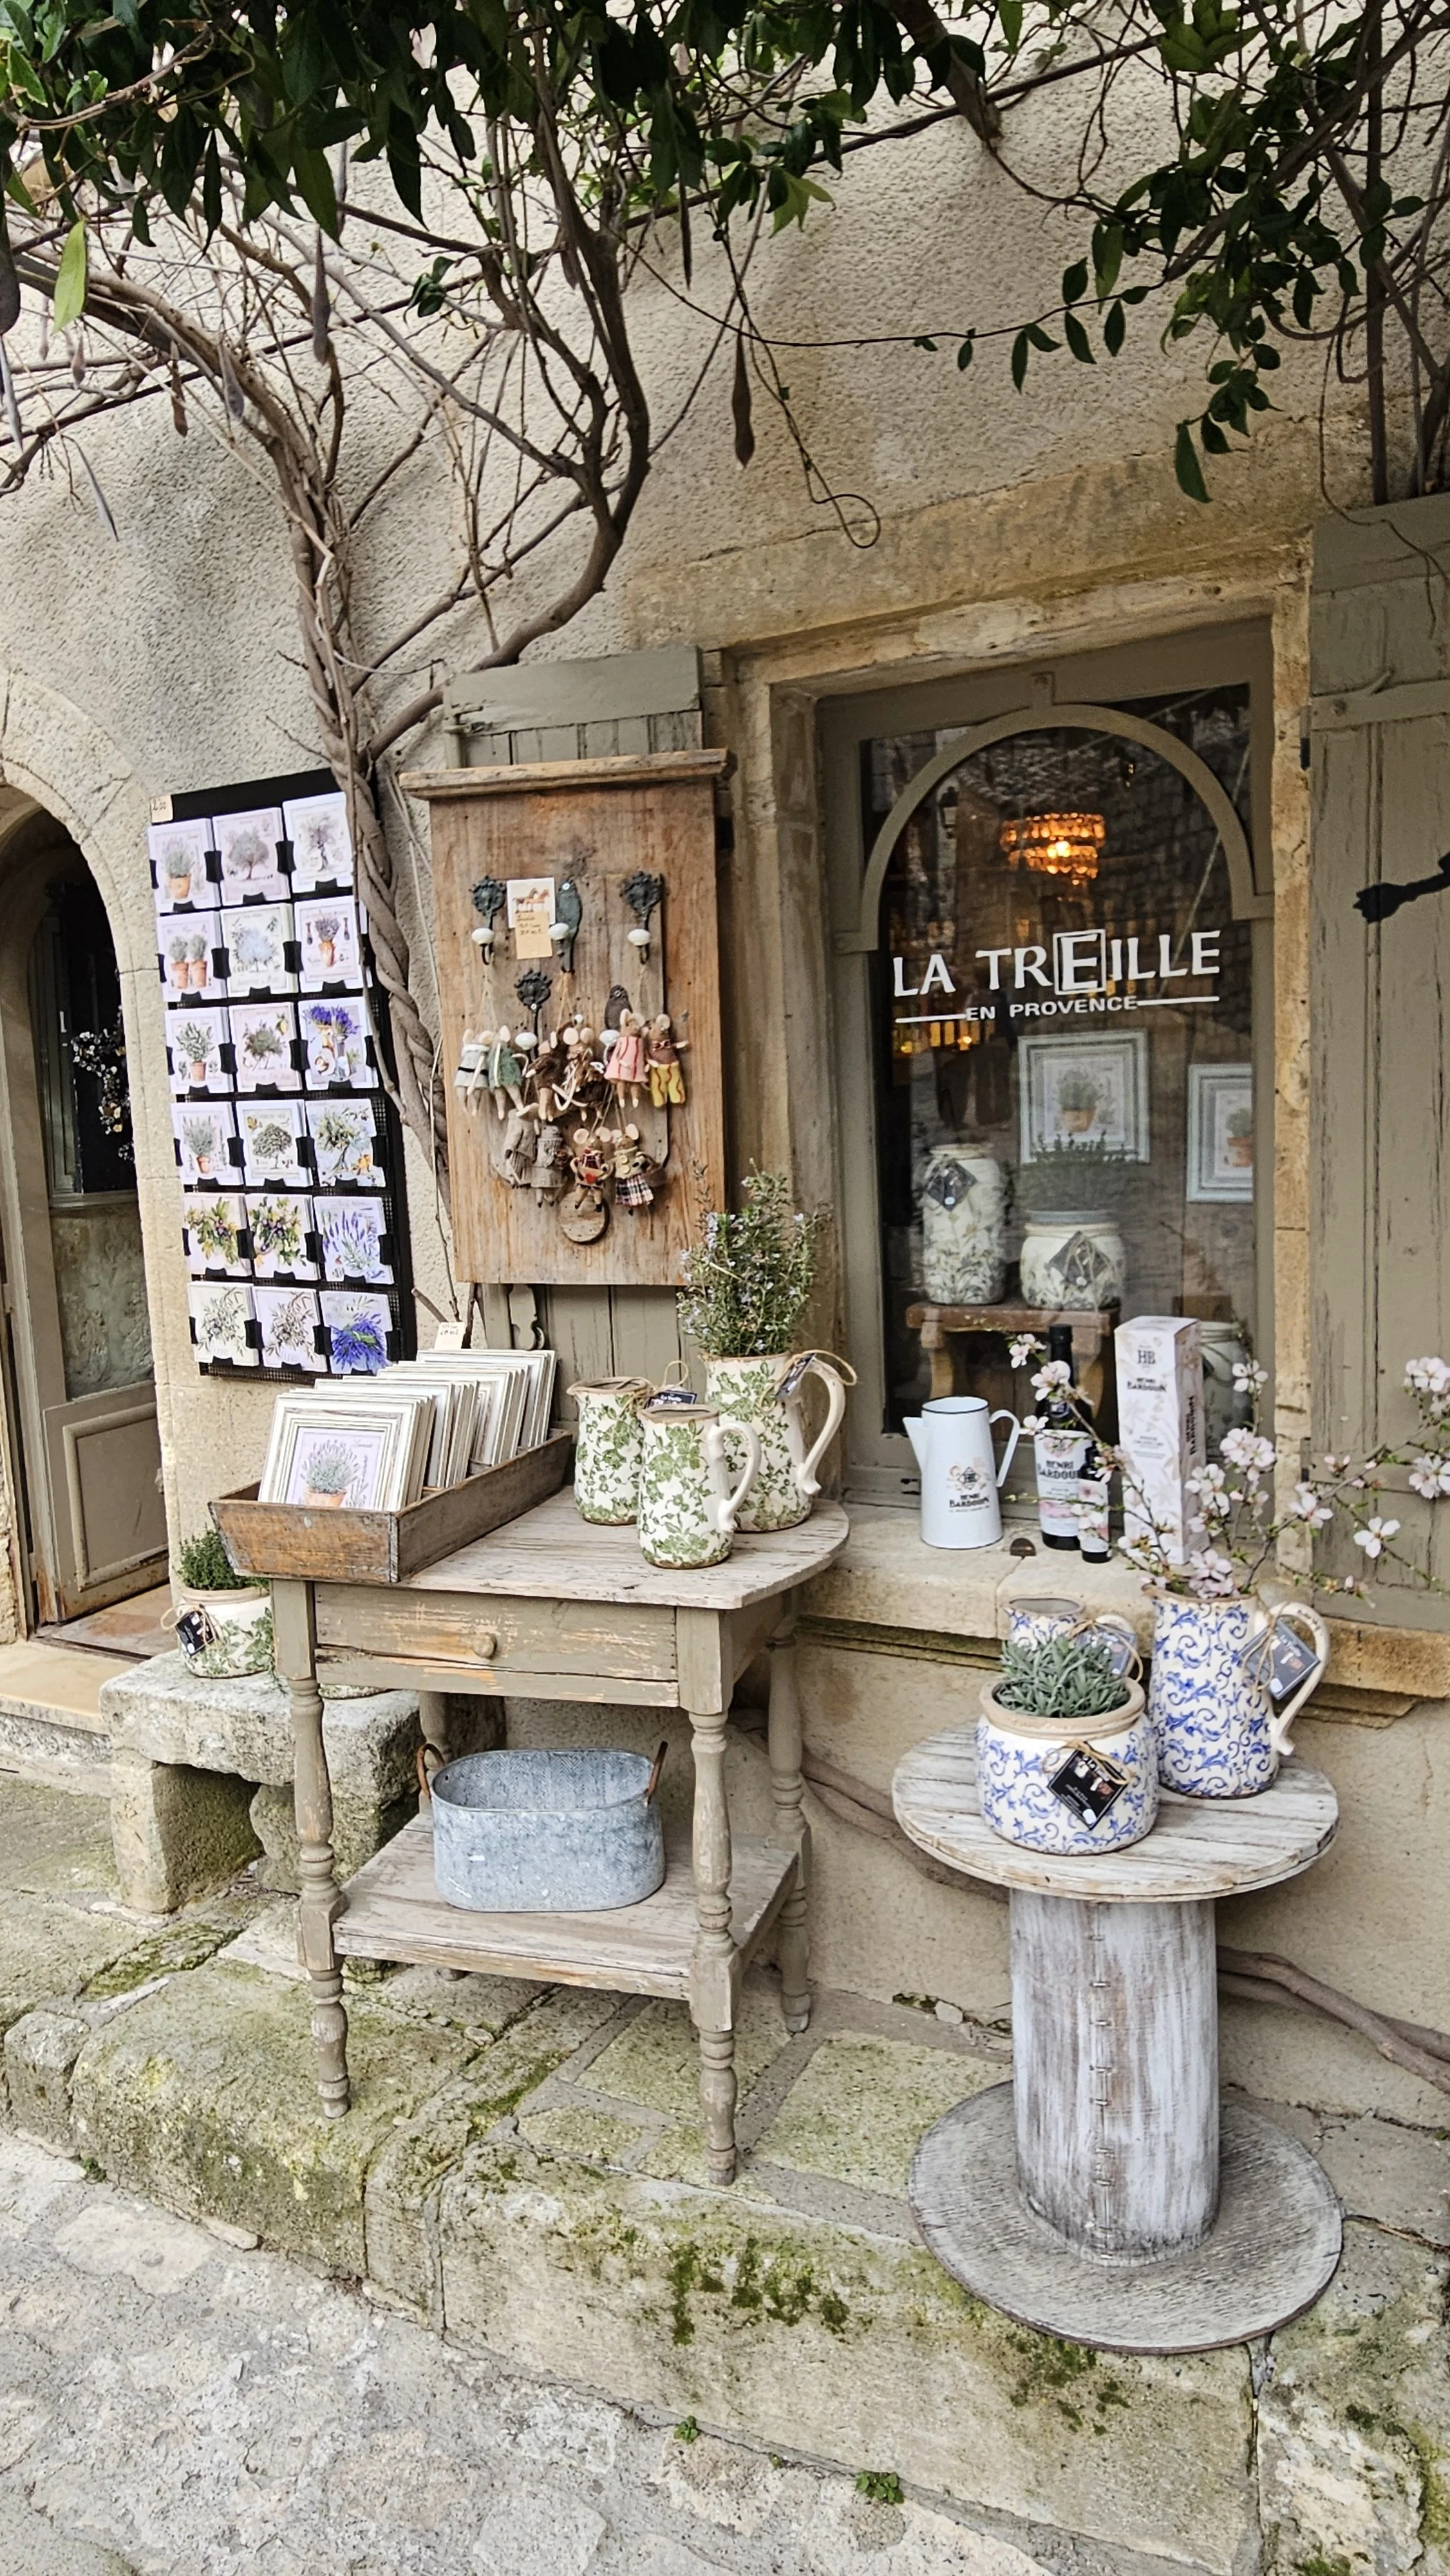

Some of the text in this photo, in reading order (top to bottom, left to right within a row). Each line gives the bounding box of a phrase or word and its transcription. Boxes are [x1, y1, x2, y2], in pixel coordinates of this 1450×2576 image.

[893, 929, 1221, 997] LA TREILLE
[966, 996, 1138, 1021] EN PROVENCE
